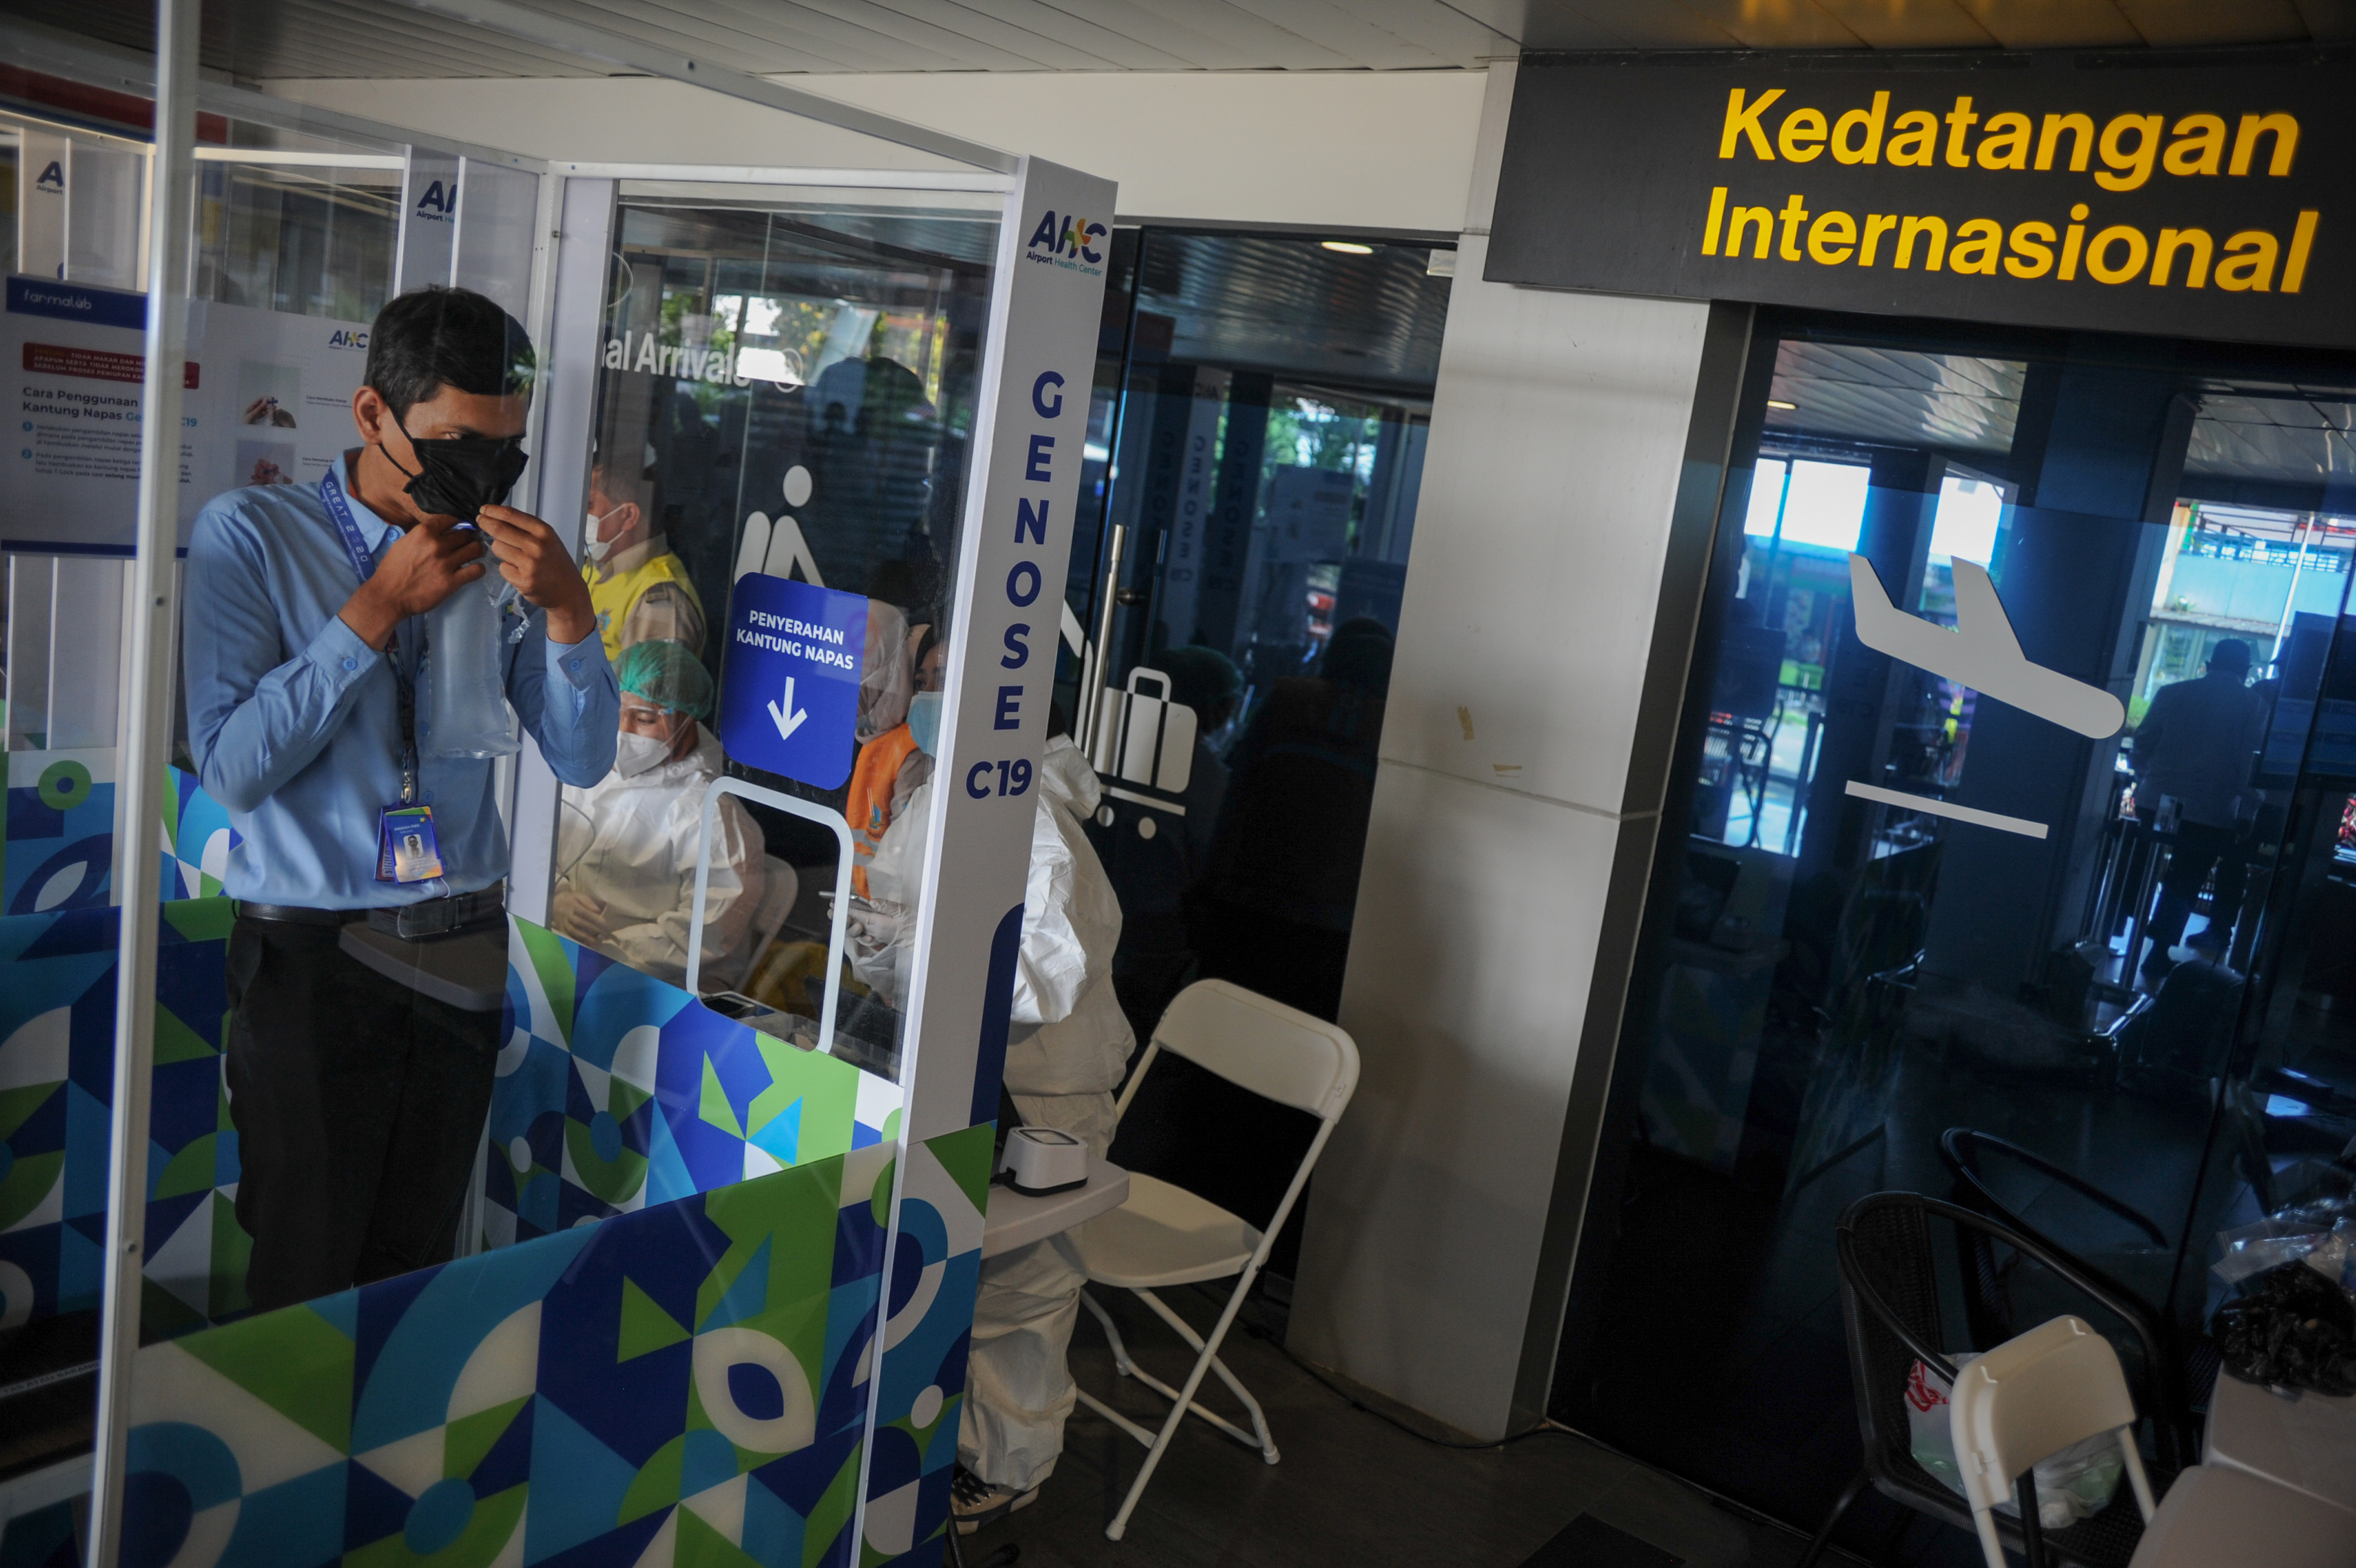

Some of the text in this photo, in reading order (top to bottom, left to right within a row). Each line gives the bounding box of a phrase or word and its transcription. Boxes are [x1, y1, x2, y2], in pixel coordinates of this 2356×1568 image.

[1718, 88, 2302, 192] Kedatangan
[416, 211, 443, 221] Airport
[1028, 210, 1107, 263] AHC
[1701, 186, 2321, 294] Internasional
[1026, 251, 1102, 276] Airport Health Center
[329, 330, 368, 349] AHC
[34, 363, 67, 371] SEBELUM
[97, 370, 131, 378] PENIUPAN
[23, 387, 138, 407] Cara Penggunaan
[23, 402, 80, 418] Kantung
[84, 408, 123, 421] Napas
[125, 412, 143, 422] Ge
[53, 454, 92, 462] pengambilan
[994, 371, 1065, 730] GENOSE
[749, 609, 845, 646] PENYERAHAN
[736, 628, 854, 670] KANTUNG NAPAS
[966, 758, 1033, 800] C19
